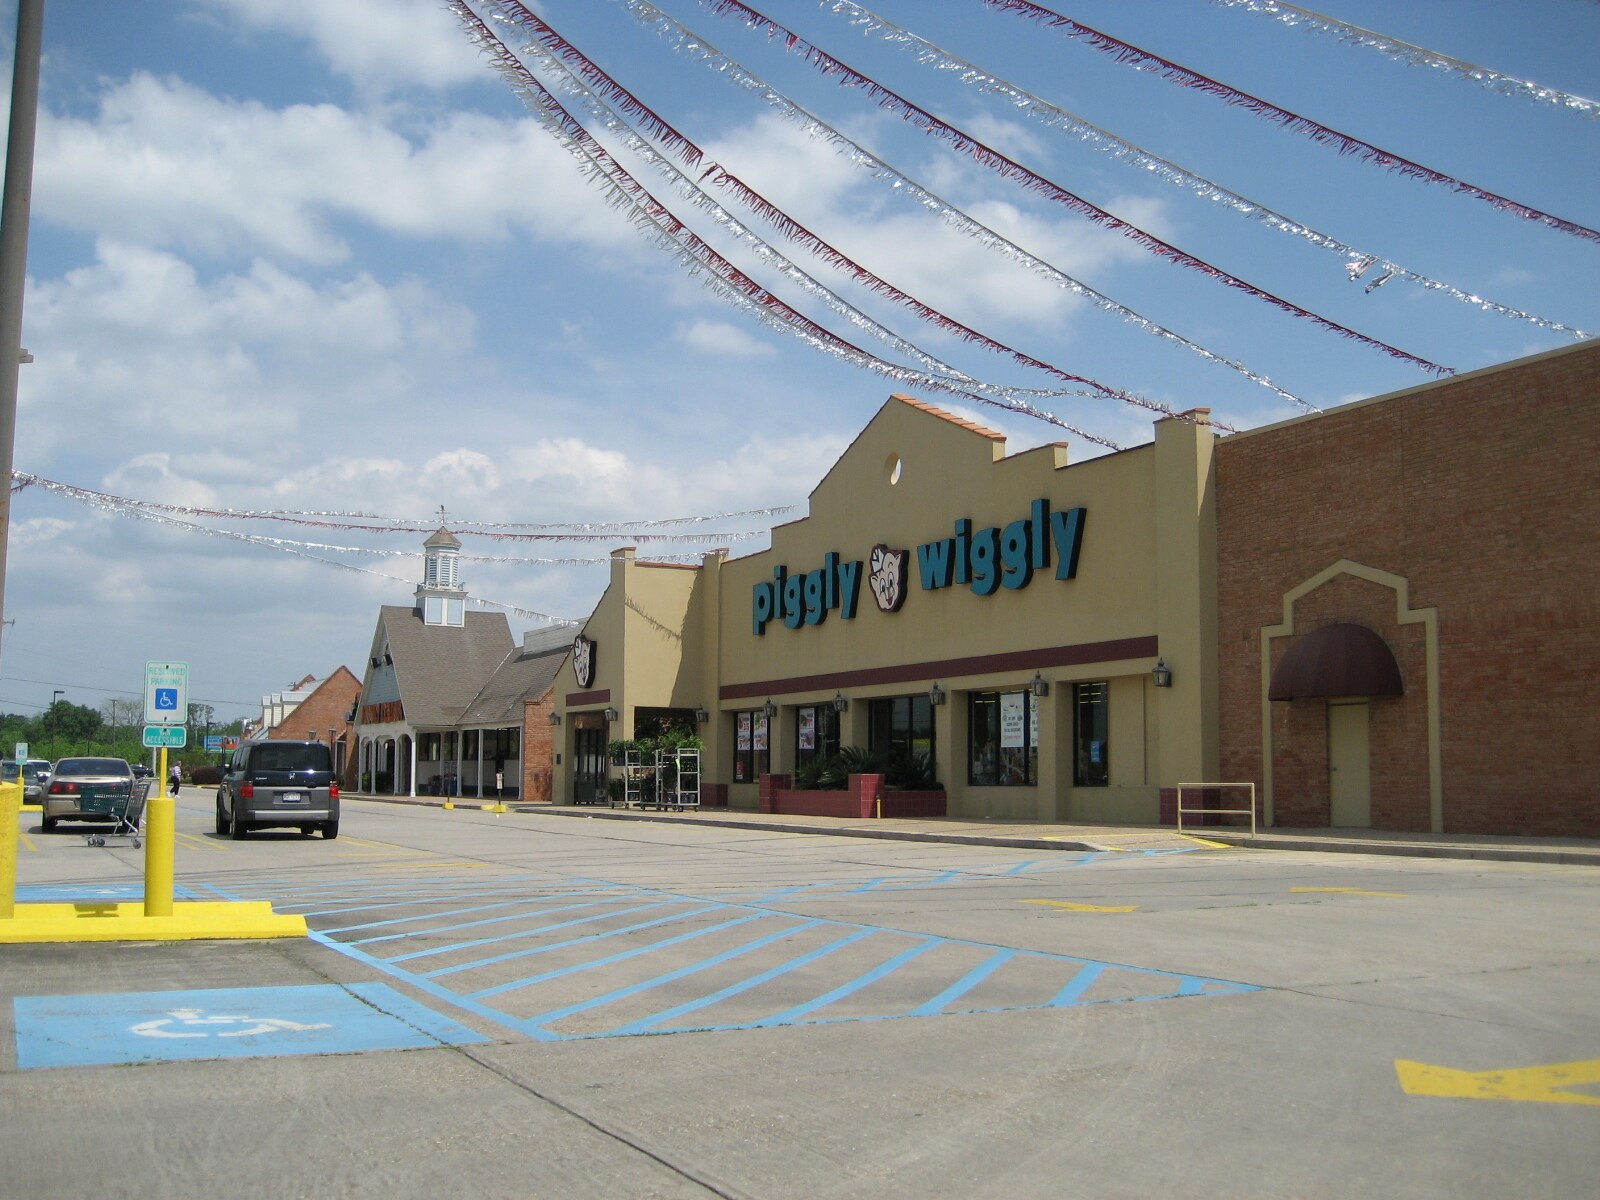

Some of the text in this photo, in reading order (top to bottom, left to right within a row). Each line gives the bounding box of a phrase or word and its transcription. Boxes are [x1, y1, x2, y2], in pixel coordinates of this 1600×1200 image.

[753, 498, 1087, 636] piggly wiggly
[146, 735, 184, 745] ACCESSIBLE
